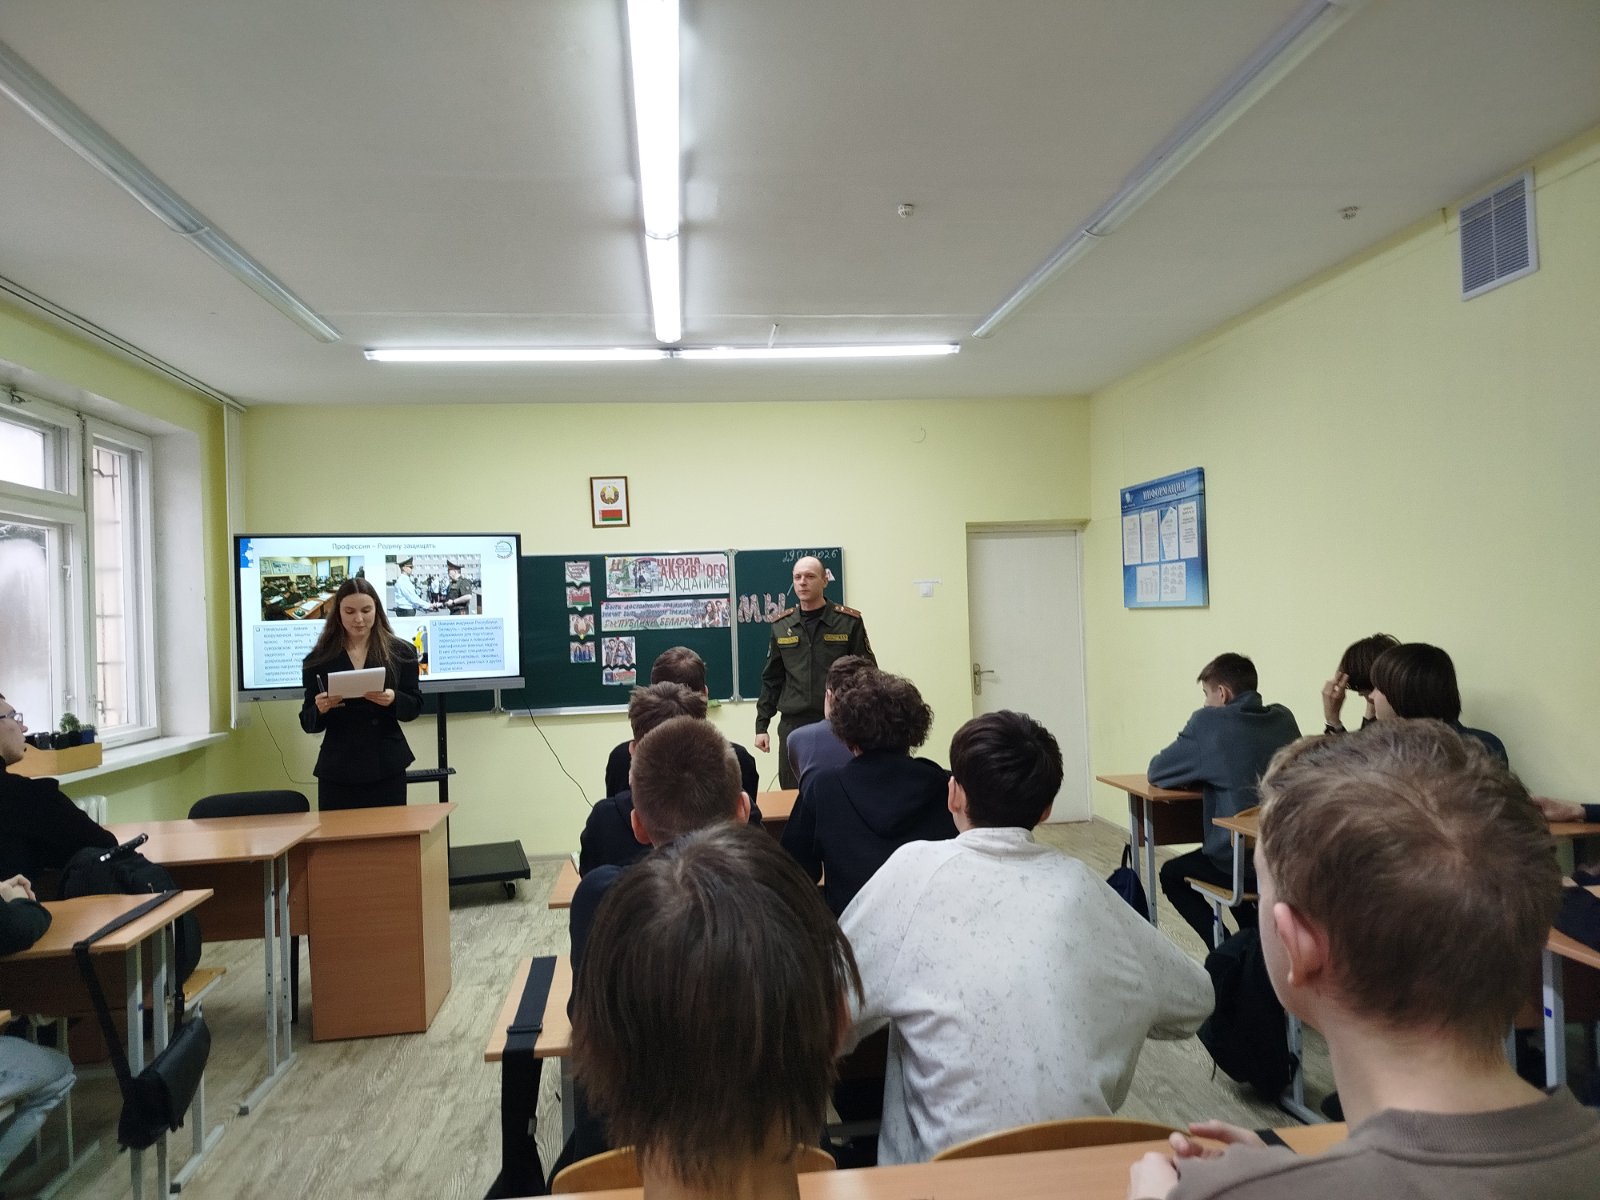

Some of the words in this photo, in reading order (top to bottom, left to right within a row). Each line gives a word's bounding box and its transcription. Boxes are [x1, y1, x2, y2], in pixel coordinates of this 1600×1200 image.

[1143, 480, 1186, 501] ИНФОРМАЦИЯ
[332, 542, 370, 551] Профессия
[377, 542, 402, 551] Родину
[656, 557, 701, 568] ШКОЛА
[660, 564, 726, 579] АКТИВНОГО
[652, 576, 728, 593] ГРАЖДАНИНА
[738, 593, 786, 623] МЫ
